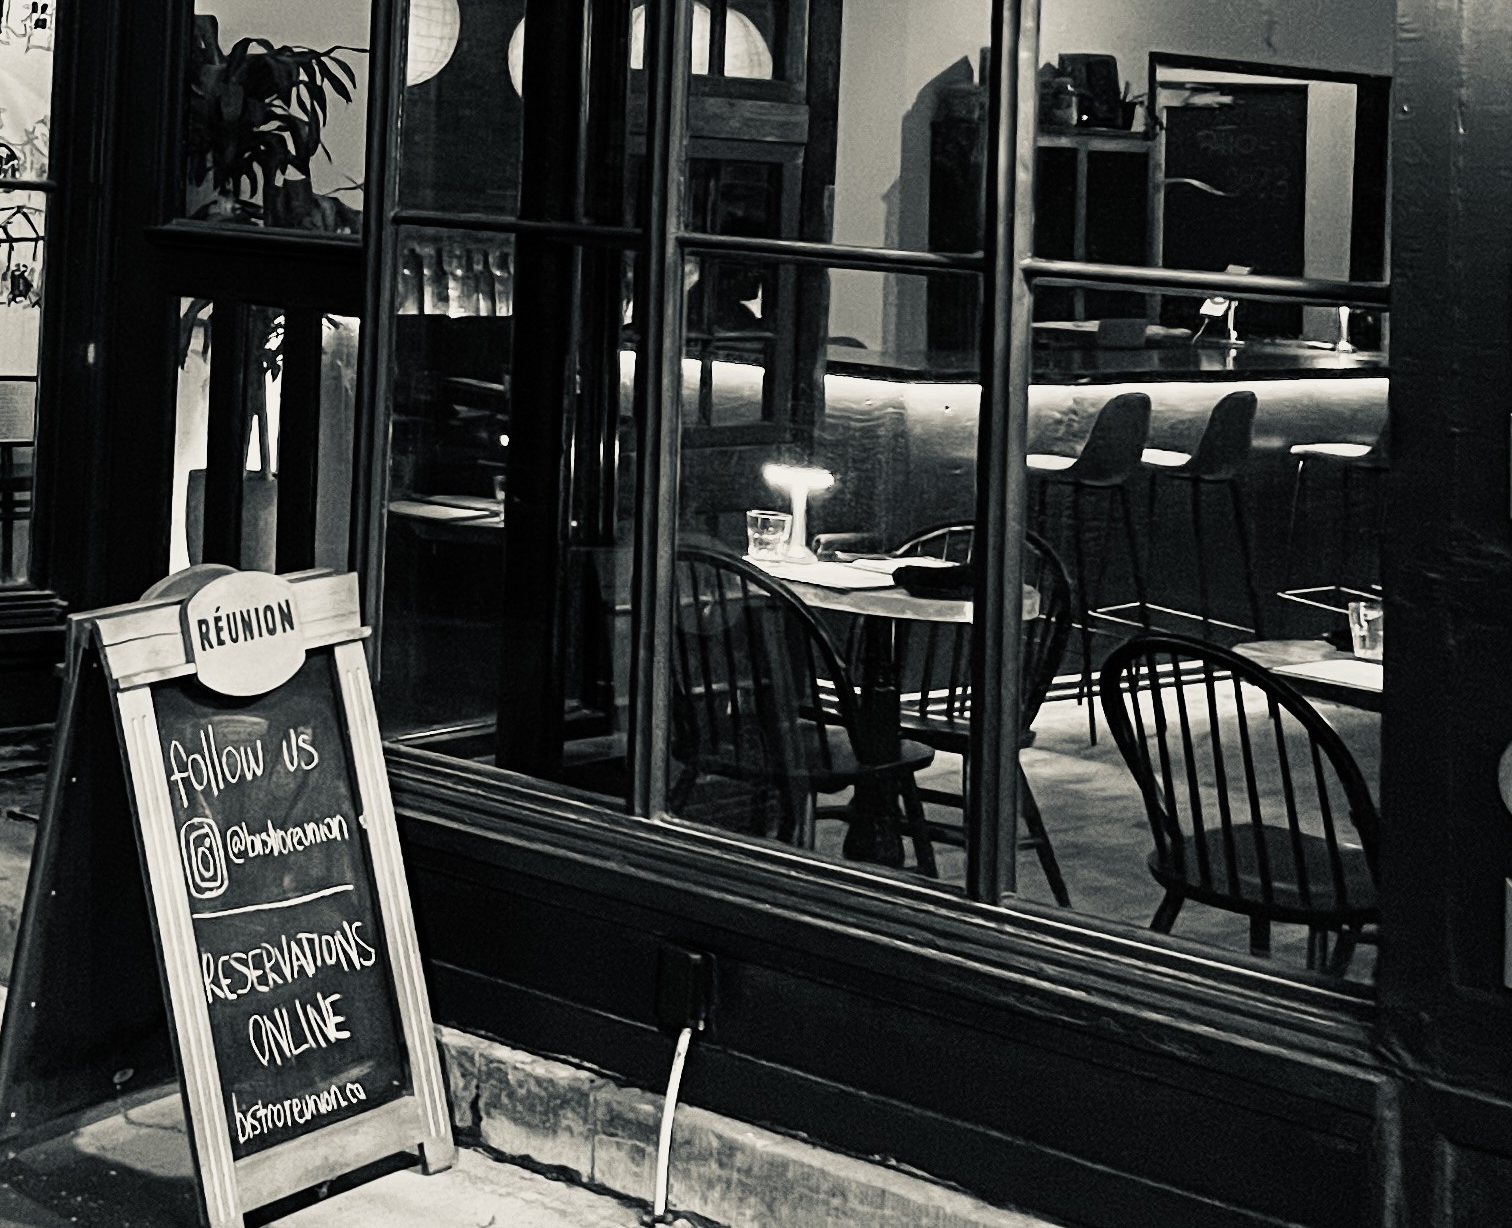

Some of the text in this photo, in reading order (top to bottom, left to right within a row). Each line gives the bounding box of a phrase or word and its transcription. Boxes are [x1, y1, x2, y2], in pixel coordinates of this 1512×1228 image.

[196, 598, 295, 652] RÉUNION
[169, 723, 264, 809] follow
[201, 920, 376, 1004] RESERVATIONS
[248, 991, 351, 1066] ONLINE
